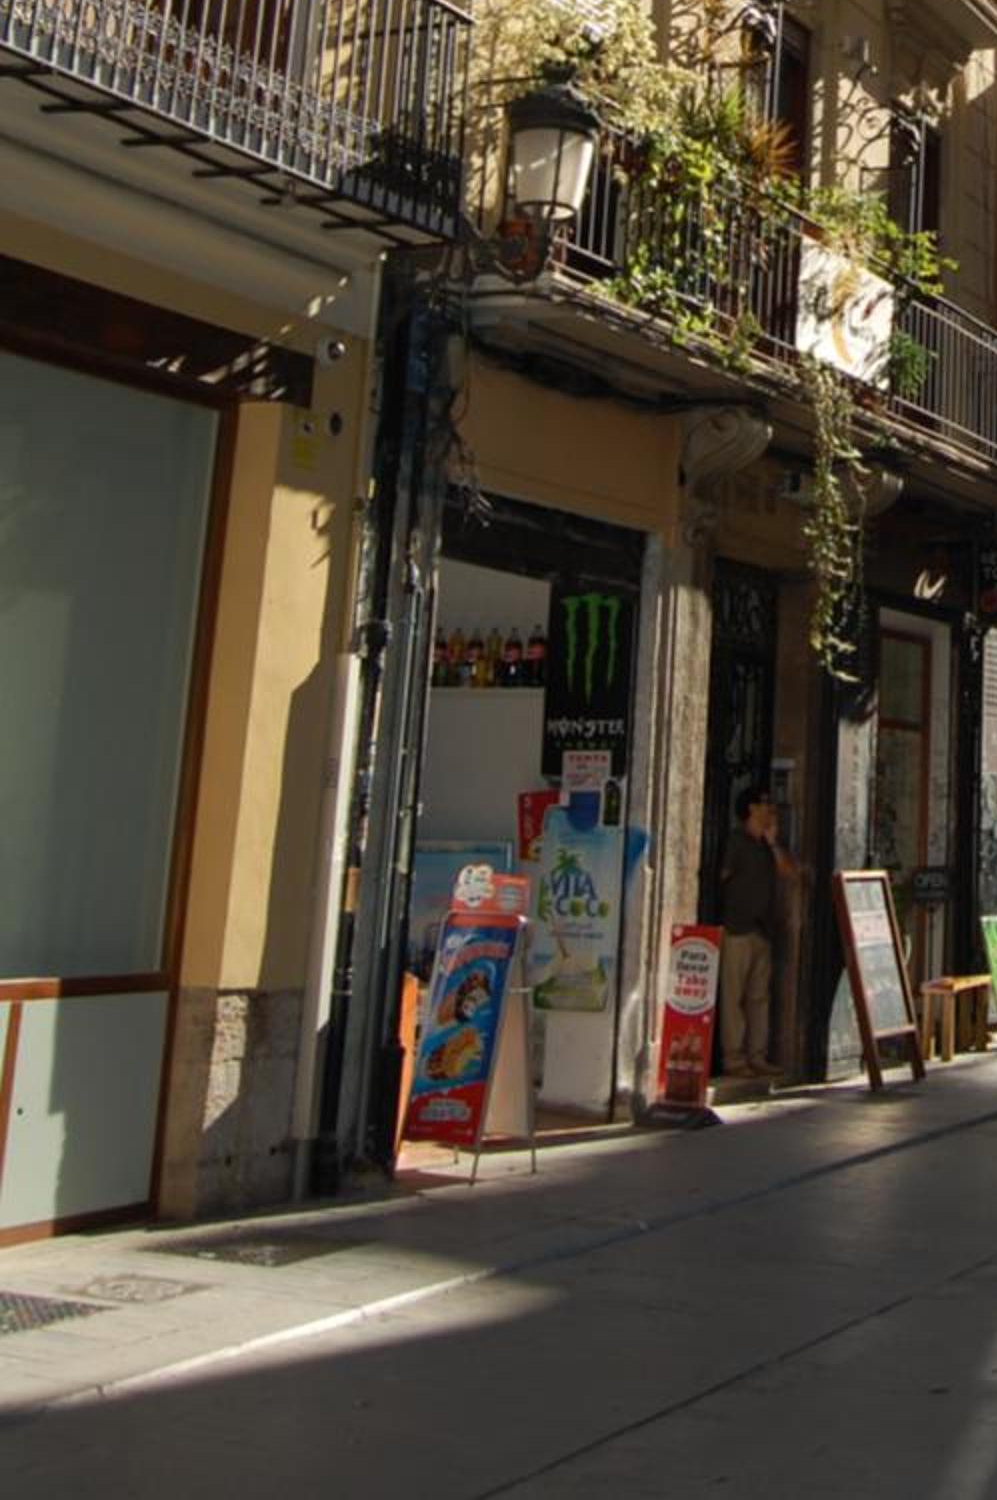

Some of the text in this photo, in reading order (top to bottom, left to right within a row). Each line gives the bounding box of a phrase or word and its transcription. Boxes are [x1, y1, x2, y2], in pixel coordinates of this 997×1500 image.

[546, 716, 626, 739] MONSTER
[680, 949, 707, 961] Para
[677, 973, 708, 985] Take
